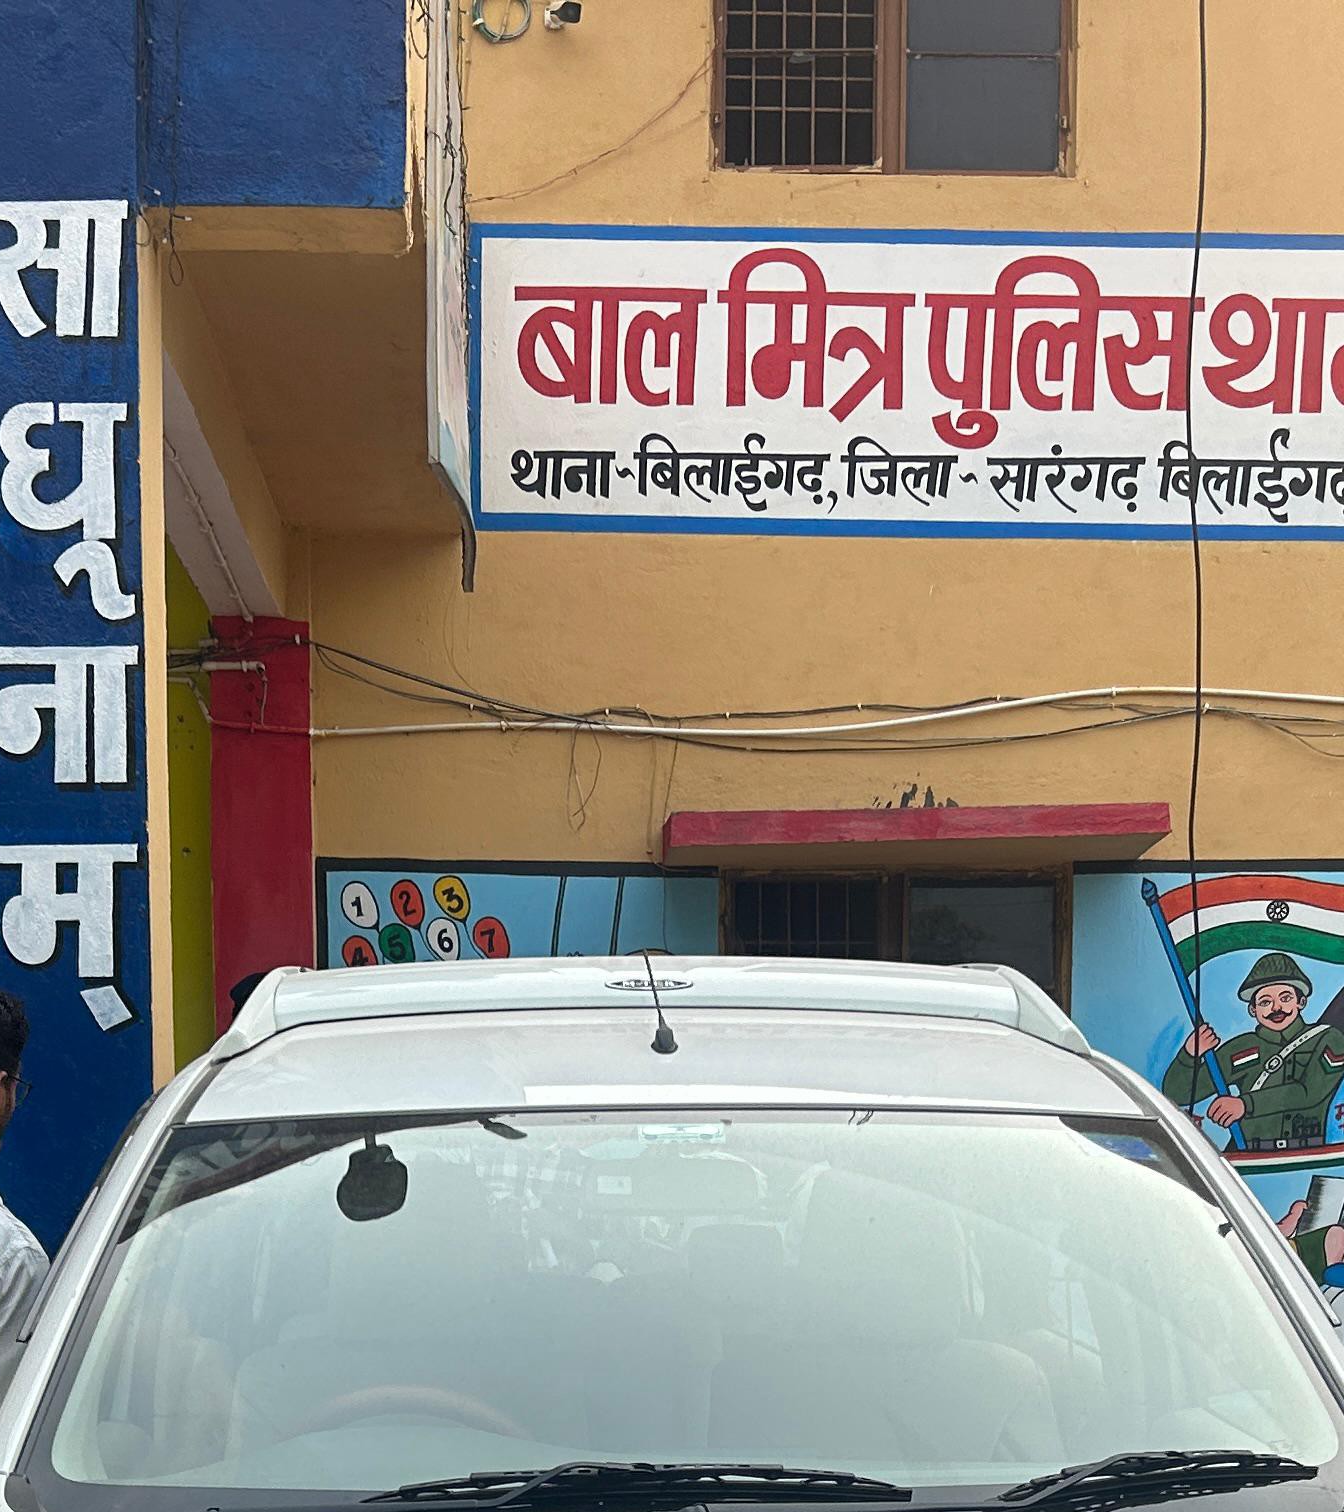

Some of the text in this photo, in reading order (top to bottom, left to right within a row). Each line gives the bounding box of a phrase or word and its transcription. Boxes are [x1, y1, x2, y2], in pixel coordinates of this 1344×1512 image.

[514, 286, 707, 407] बाल
[717, 247, 916, 423] मित्र
[924, 255, 1205, 449] पुलिस
[987, 444, 1146, 513] सारंगढ़
[351, 886, 464, 917] 1 2 3
[351, 928, 496, 967] 4 5 6 7
